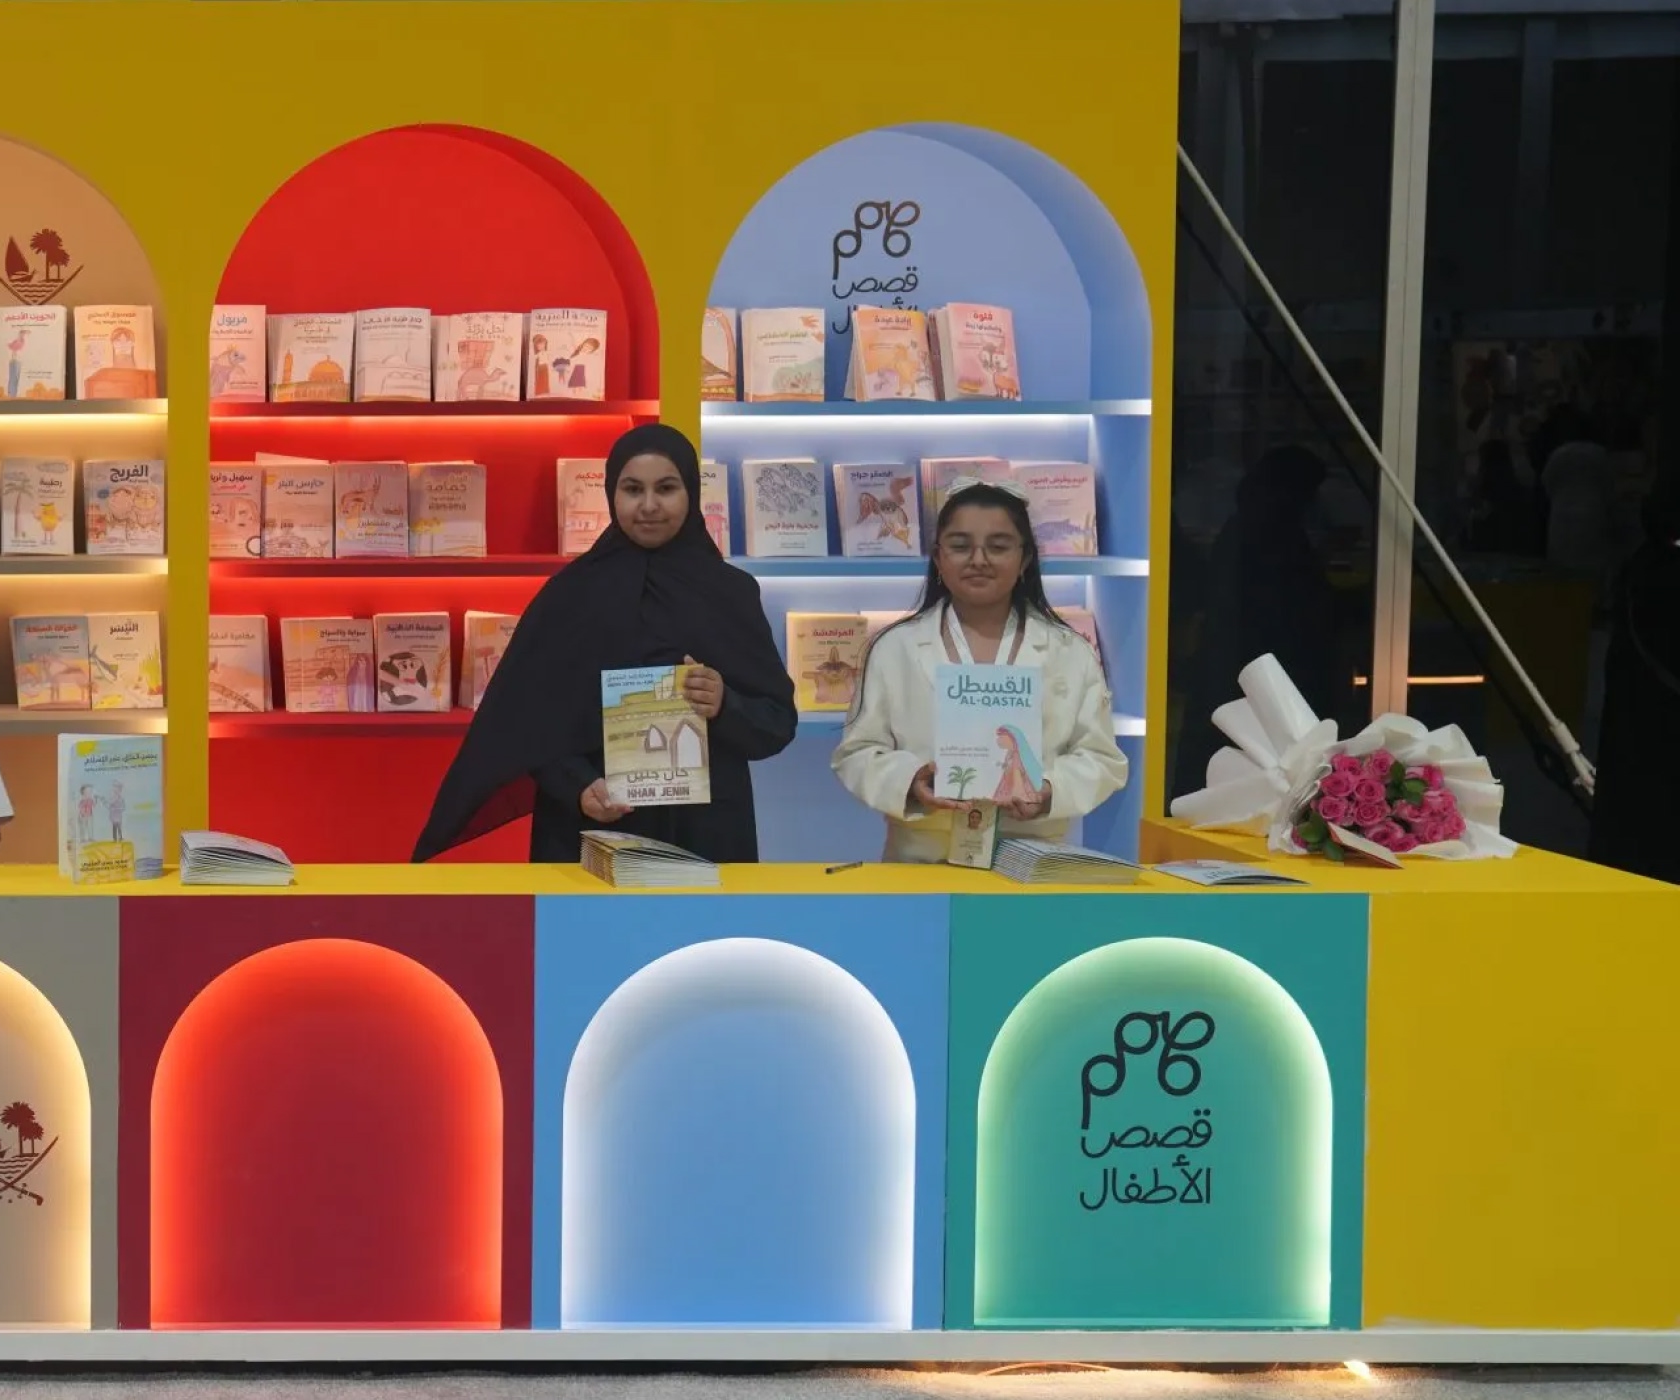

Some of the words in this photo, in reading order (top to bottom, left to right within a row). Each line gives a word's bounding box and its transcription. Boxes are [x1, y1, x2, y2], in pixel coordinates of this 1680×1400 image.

[832, 265, 919, 299] قصص
[110, 465, 149, 483] الفريج
[947, 675, 1032, 699] القسطل
[960, 696, 1032, 708] AL-QASTAL
[627, 786, 656, 799] KHAN
[661, 786, 690, 797] JENIN
[1081, 1108, 1212, 1158] قصص
[1079, 1153, 1212, 1211] الأطفال
